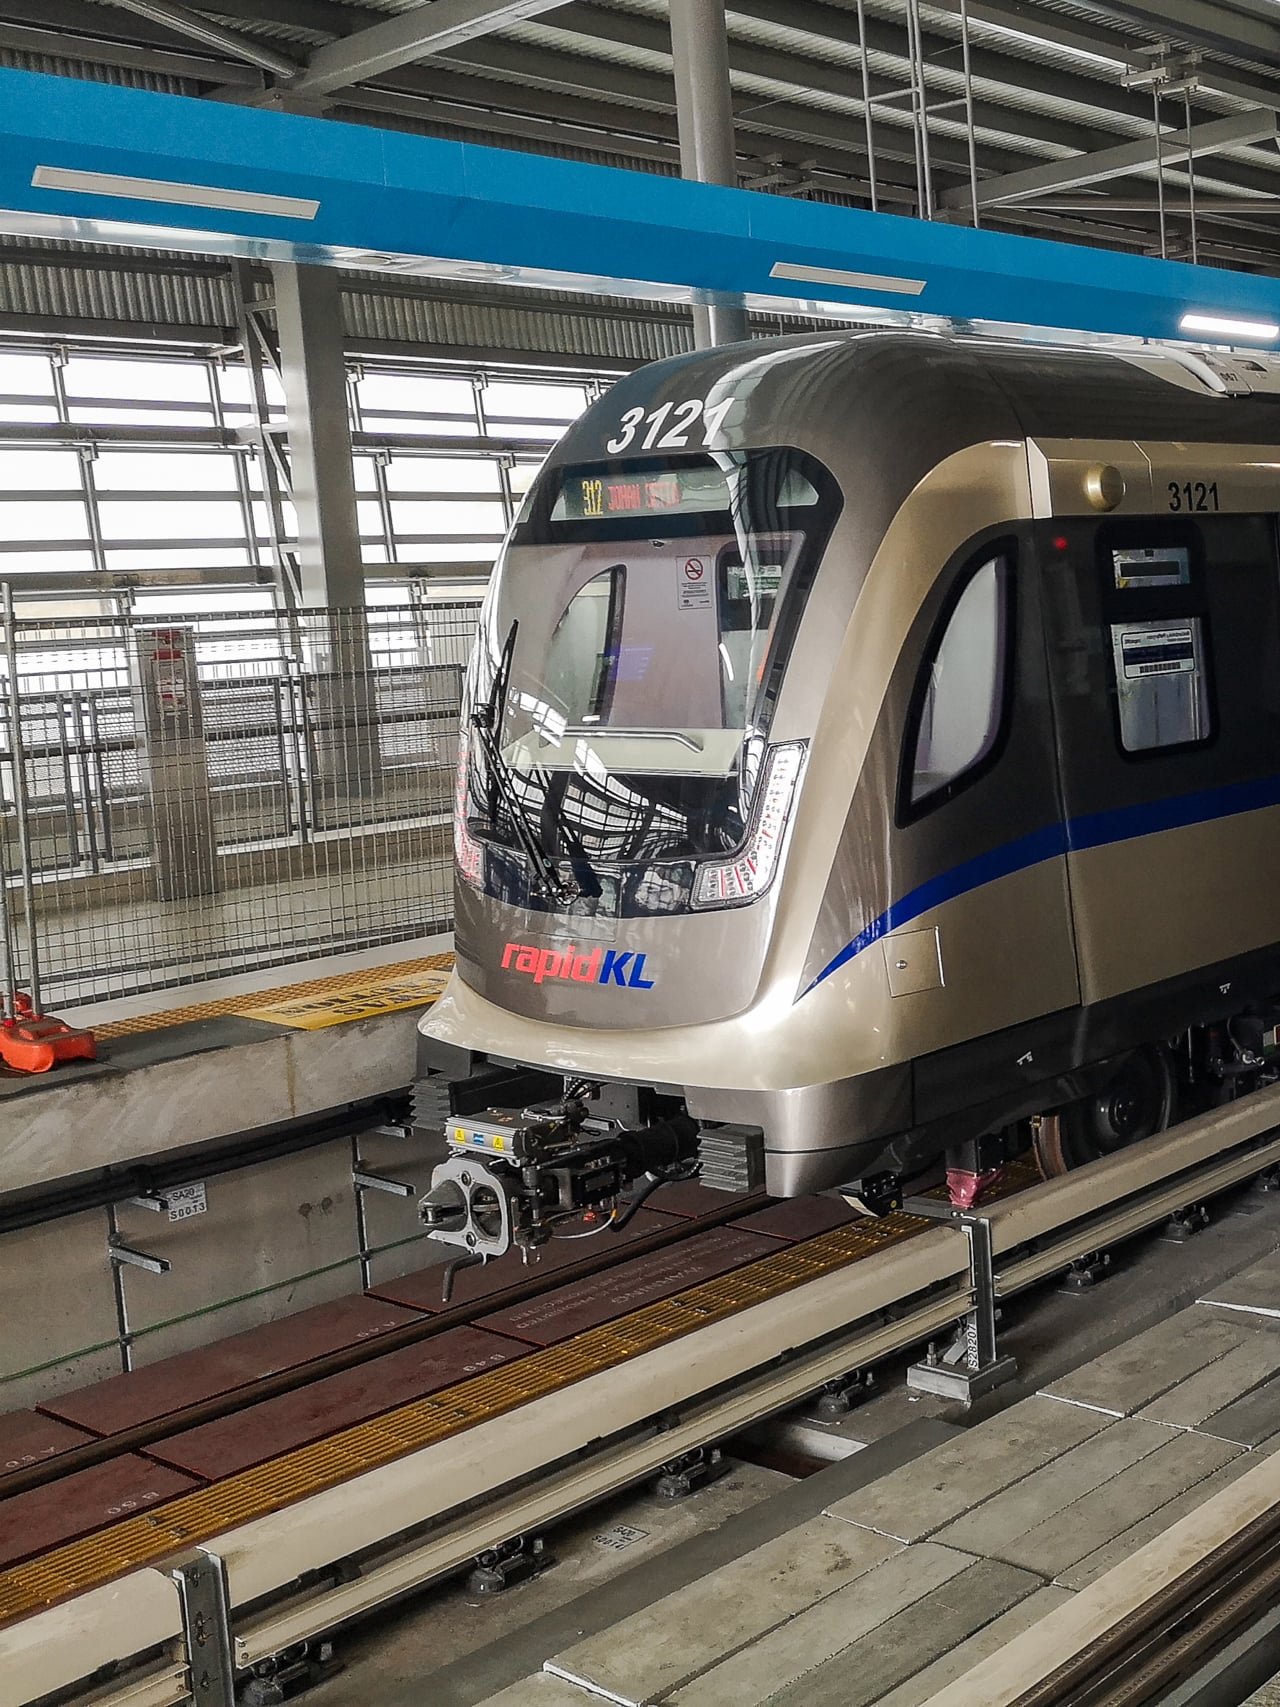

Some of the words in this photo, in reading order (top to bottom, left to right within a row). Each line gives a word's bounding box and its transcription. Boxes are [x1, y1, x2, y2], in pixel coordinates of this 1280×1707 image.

[606, 397, 735, 454] 3121
[582, 479, 604, 516] 312
[1168, 482, 1220, 511] 3121
[500, 943, 655, 989] rapidKL
[967, 1324, 978, 1368] S28207
